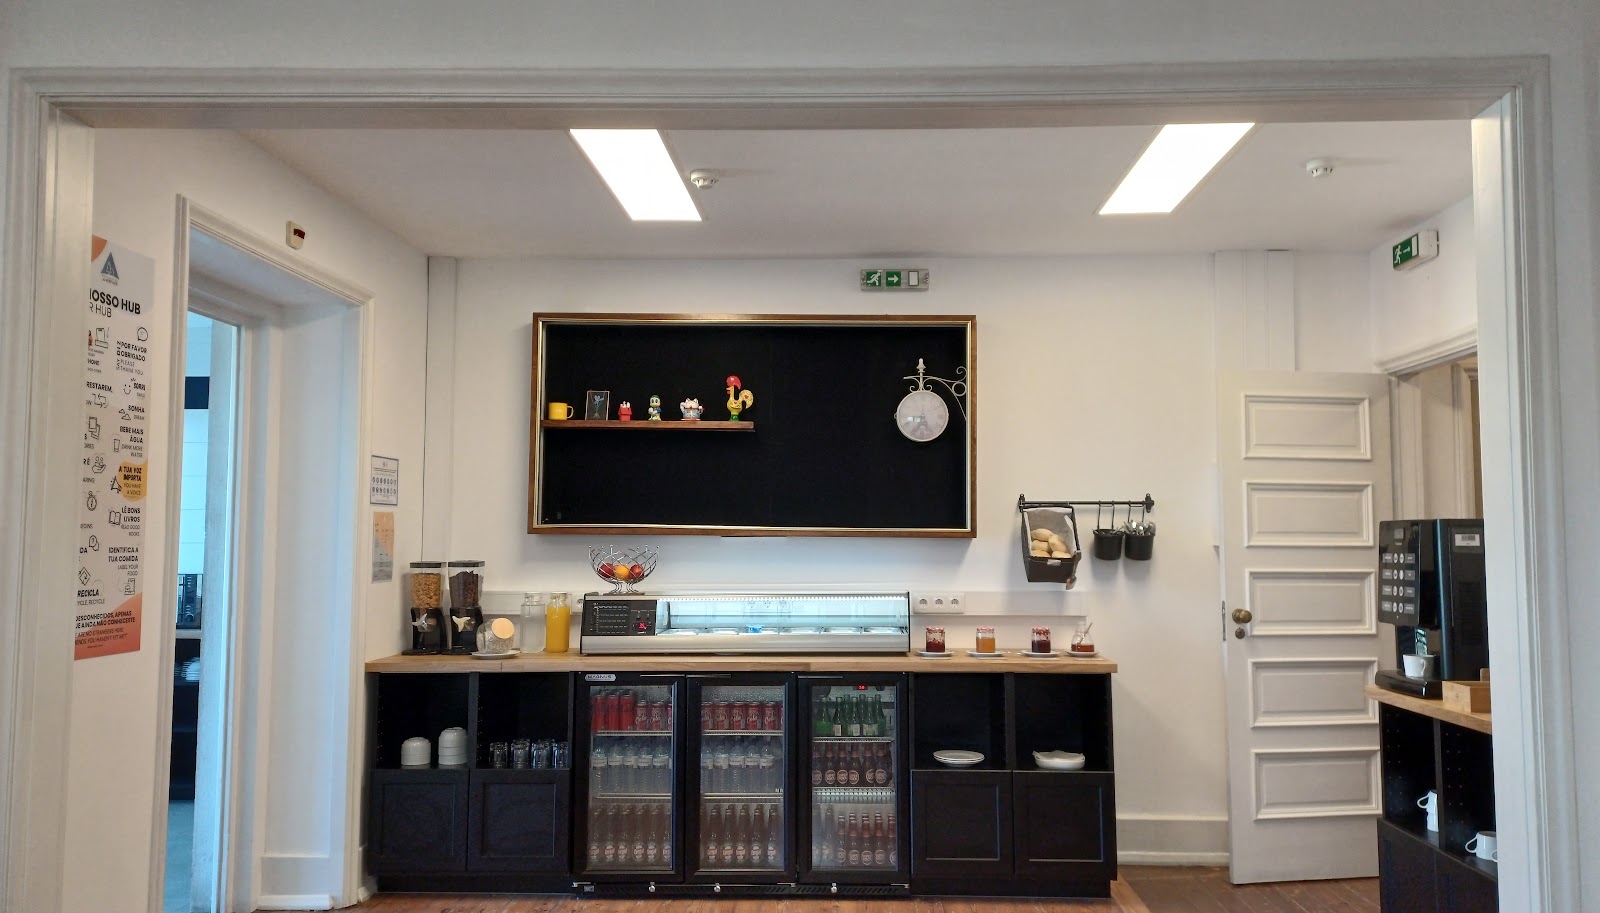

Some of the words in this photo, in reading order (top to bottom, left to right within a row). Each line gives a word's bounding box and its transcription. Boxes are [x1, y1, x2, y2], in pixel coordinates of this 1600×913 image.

[95, 303, 112, 318] HUB
[121, 298, 141, 315] HUB
[131, 344, 147, 354] FAVOR
[120, 350, 146, 362] OBRIGADO
[128, 404, 145, 413] SONHA
[123, 466, 133, 474] TUA
[123, 473, 142, 482] IMPORTA
[123, 515, 141, 523] LIVROS
[108, 546, 135, 554] IDENTIFICA
[108, 555, 118, 563] TUA
[77, 588, 100, 598] RECICLA
[107, 616, 136, 626] CONHECESTE
